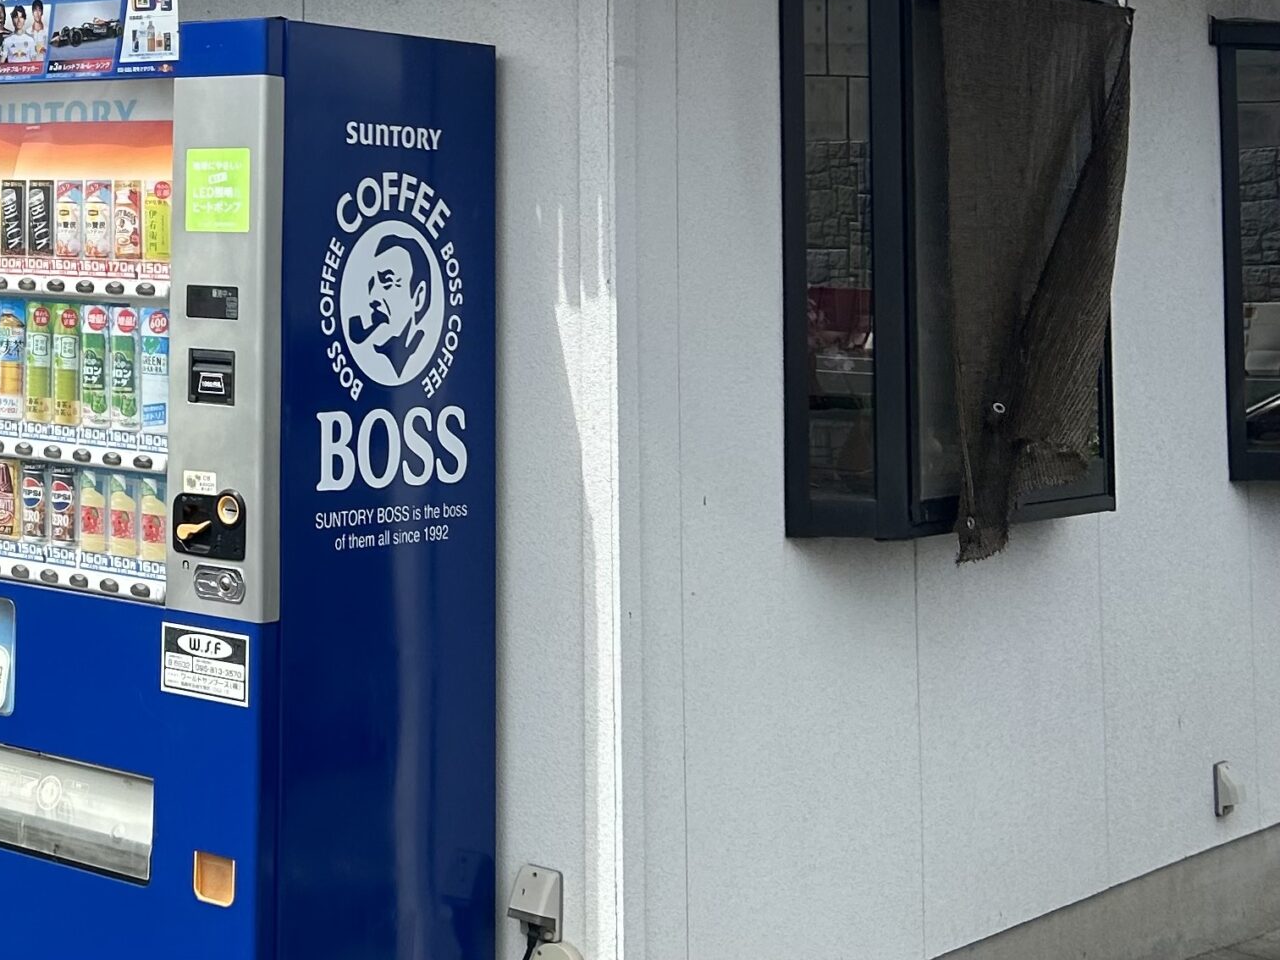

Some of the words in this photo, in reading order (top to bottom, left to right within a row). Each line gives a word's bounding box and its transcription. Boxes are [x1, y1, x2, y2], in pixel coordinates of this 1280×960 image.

[346, 120, 442, 150] SUNTORY
[5, 203, 22, 249] BLACK
[30, 203, 50, 250] BLACK
[336, 171, 452, 240] COFFEE
[319, 236, 346, 336] COFFEE
[440, 240, 464, 306] BOSS
[150, 317, 167, 329] 600
[326, 339, 364, 402] BOSS
[421, 318, 463, 399] COFFEE
[316, 405, 469, 492] BOSS
[315, 508, 374, 530] SUNTORY
[377, 505, 410, 524] BOSS
[412, 504, 422, 521] is
[423, 504, 441, 520] the
[443, 502, 469, 519] boss
[334, 533, 348, 552] of
[348, 532, 376, 549] them
[377, 530, 390, 547] all
[392, 528, 421, 546] since
[423, 525, 450, 543] 1992
[189, 637, 221, 655] W.S.F
